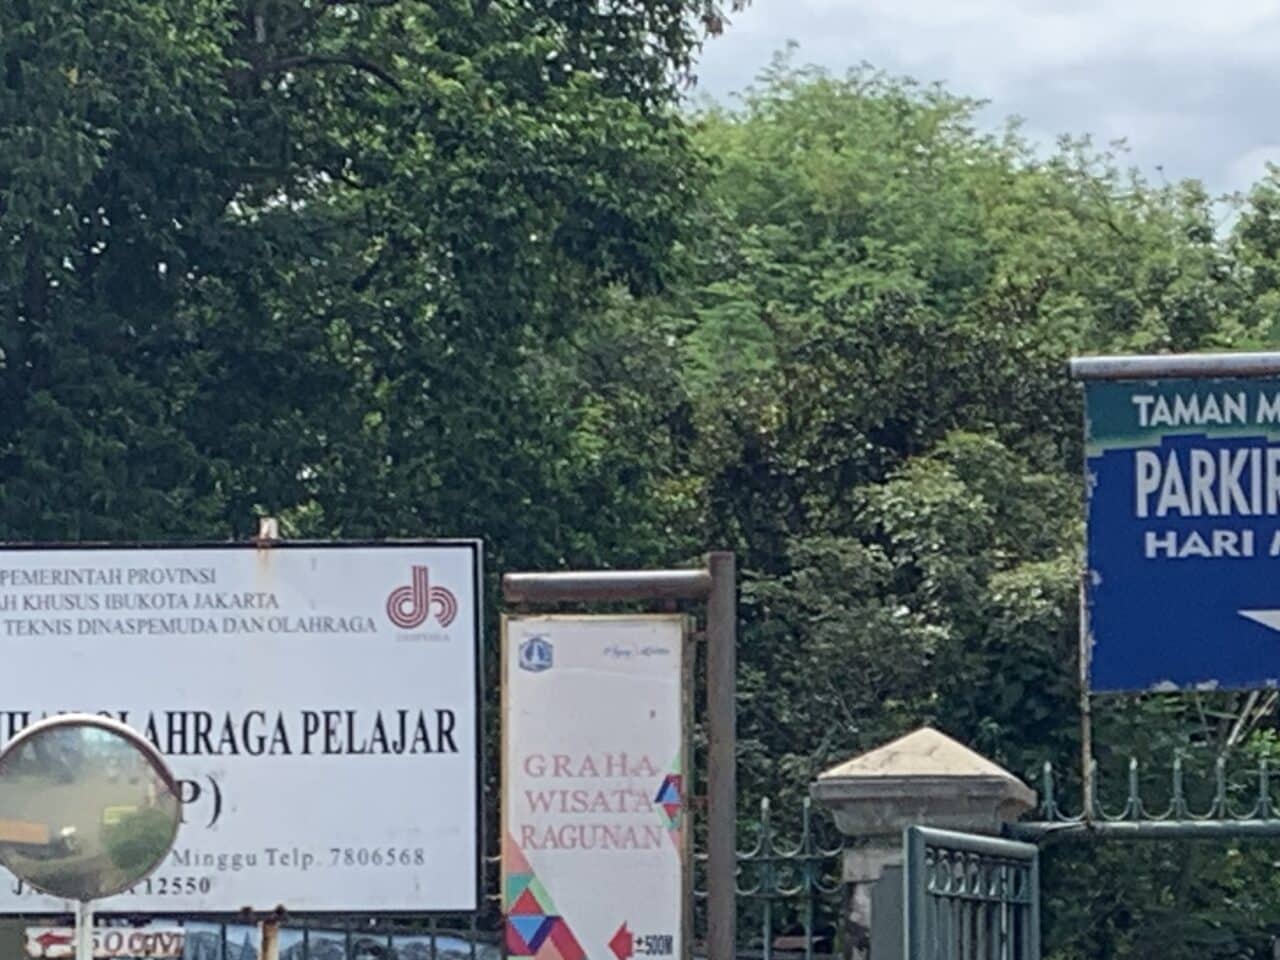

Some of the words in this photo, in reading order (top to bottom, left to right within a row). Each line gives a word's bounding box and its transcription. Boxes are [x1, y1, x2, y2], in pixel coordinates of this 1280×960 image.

[1132, 393, 1247, 428] TAMAN
[1144, 529, 1254, 559] HARI
[0, 567, 122, 586] PEMERINTAH
[127, 567, 217, 585] PROVINSI
[23, 593, 100, 611] KHUSUS
[105, 592, 189, 610] IBUKOTA
[193, 592, 280, 610] JAKARTA
[4, 618, 73, 637] TEKNIS
[222, 617, 266, 634] DAN
[267, 616, 378, 634] OLAHRAGA
[301, 708, 459, 755] PELAJAR
[523, 752, 657, 778] GRAHA
[525, 787, 653, 814] WISATA
[521, 823, 663, 850] RAGUNAN
[172, 849, 257, 870] Minggu
[329, 848, 426, 867] 7806568
